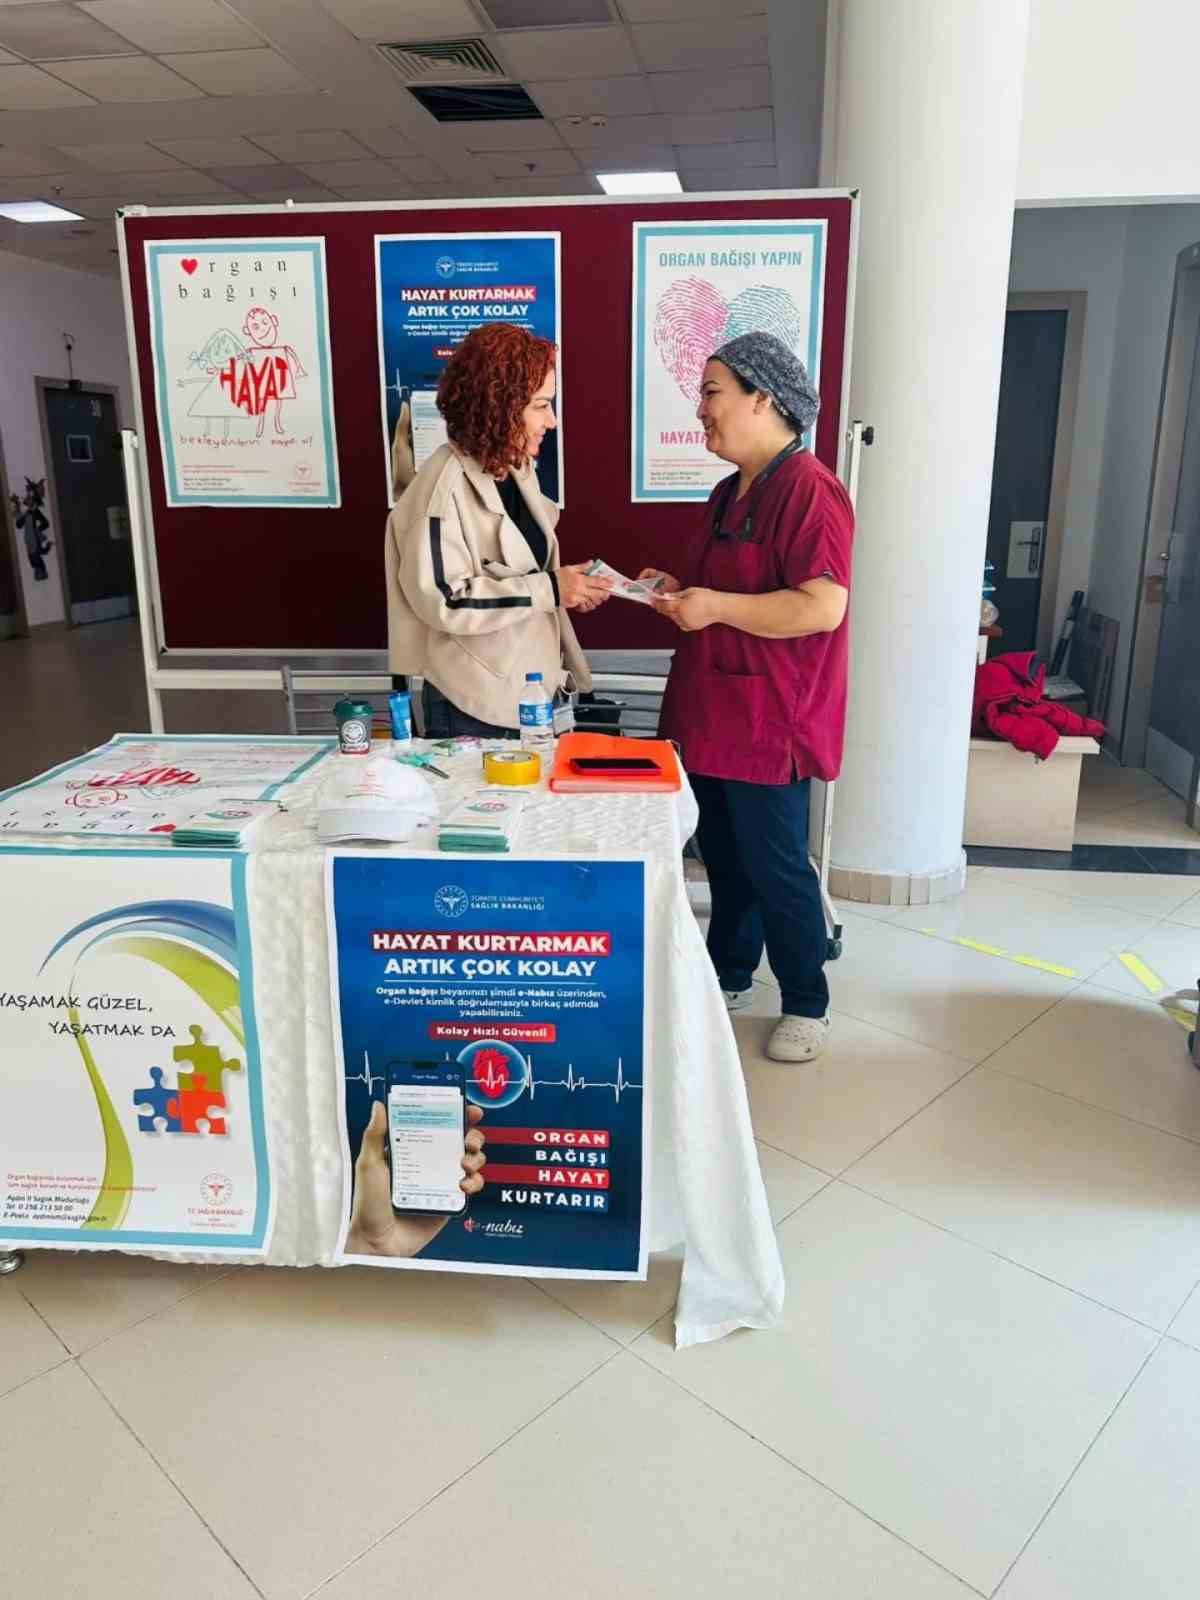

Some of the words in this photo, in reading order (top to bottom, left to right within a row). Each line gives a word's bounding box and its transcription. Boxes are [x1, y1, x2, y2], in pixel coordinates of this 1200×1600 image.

[659, 252, 705, 267] ORGAN
[711, 249, 756, 270] BAĞIŞI
[761, 251, 802, 266] YAPIN
[178, 283, 297, 302] bağışı
[401, 289, 449, 301] HAYAT
[450, 287, 536, 301] KURTARMAK
[408, 305, 448, 317] ARTIK
[452, 305, 480, 319] ÇOK
[484, 304, 528, 316] KOLAY
[219, 357, 289, 415] HAYAT
[471, 901, 498, 910] SAĞLIK
[373, 934, 451, 951] HAYAT
[458, 935, 607, 953] KURTARMAK
[384, 959, 454, 974] ARTIK
[462, 959, 511, 980] ÇOK
[518, 960, 597, 976] KOLAY
[376, 986, 406, 996] Organ
[408, 986, 438, 997] bağışı
[490, 988, 516, 998] şimdi
[556, 989, 607, 999] üzerinden,
[0, 992, 80, 1011] YAŞAMAK
[87, 993, 153, 1012] GÜZEL,
[384, 997, 424, 1006] e-Devlet
[426, 997, 455, 1006] kimlik
[457, 998, 529, 1008] doğrulamasıyla
[531, 999, 561, 1009] birkaç
[563, 1000, 599, 1008] adımda
[460, 1008, 524, 1018] yapabilirsiniz.
[48, 1021, 144, 1038] YAŞATMAK
[151, 1024, 176, 1037] DA
[437, 1027, 470, 1038] Kolay
[473, 1027, 499, 1037] Hızlı
[502, 1028, 547, 1037] Güvenli
[533, 1131, 606, 1144] ORGAN
[535, 1148, 606, 1167] BAĞIŞI
[538, 1170, 606, 1184] HAYAT
[501, 1189, 605, 1209] KURTARIR
